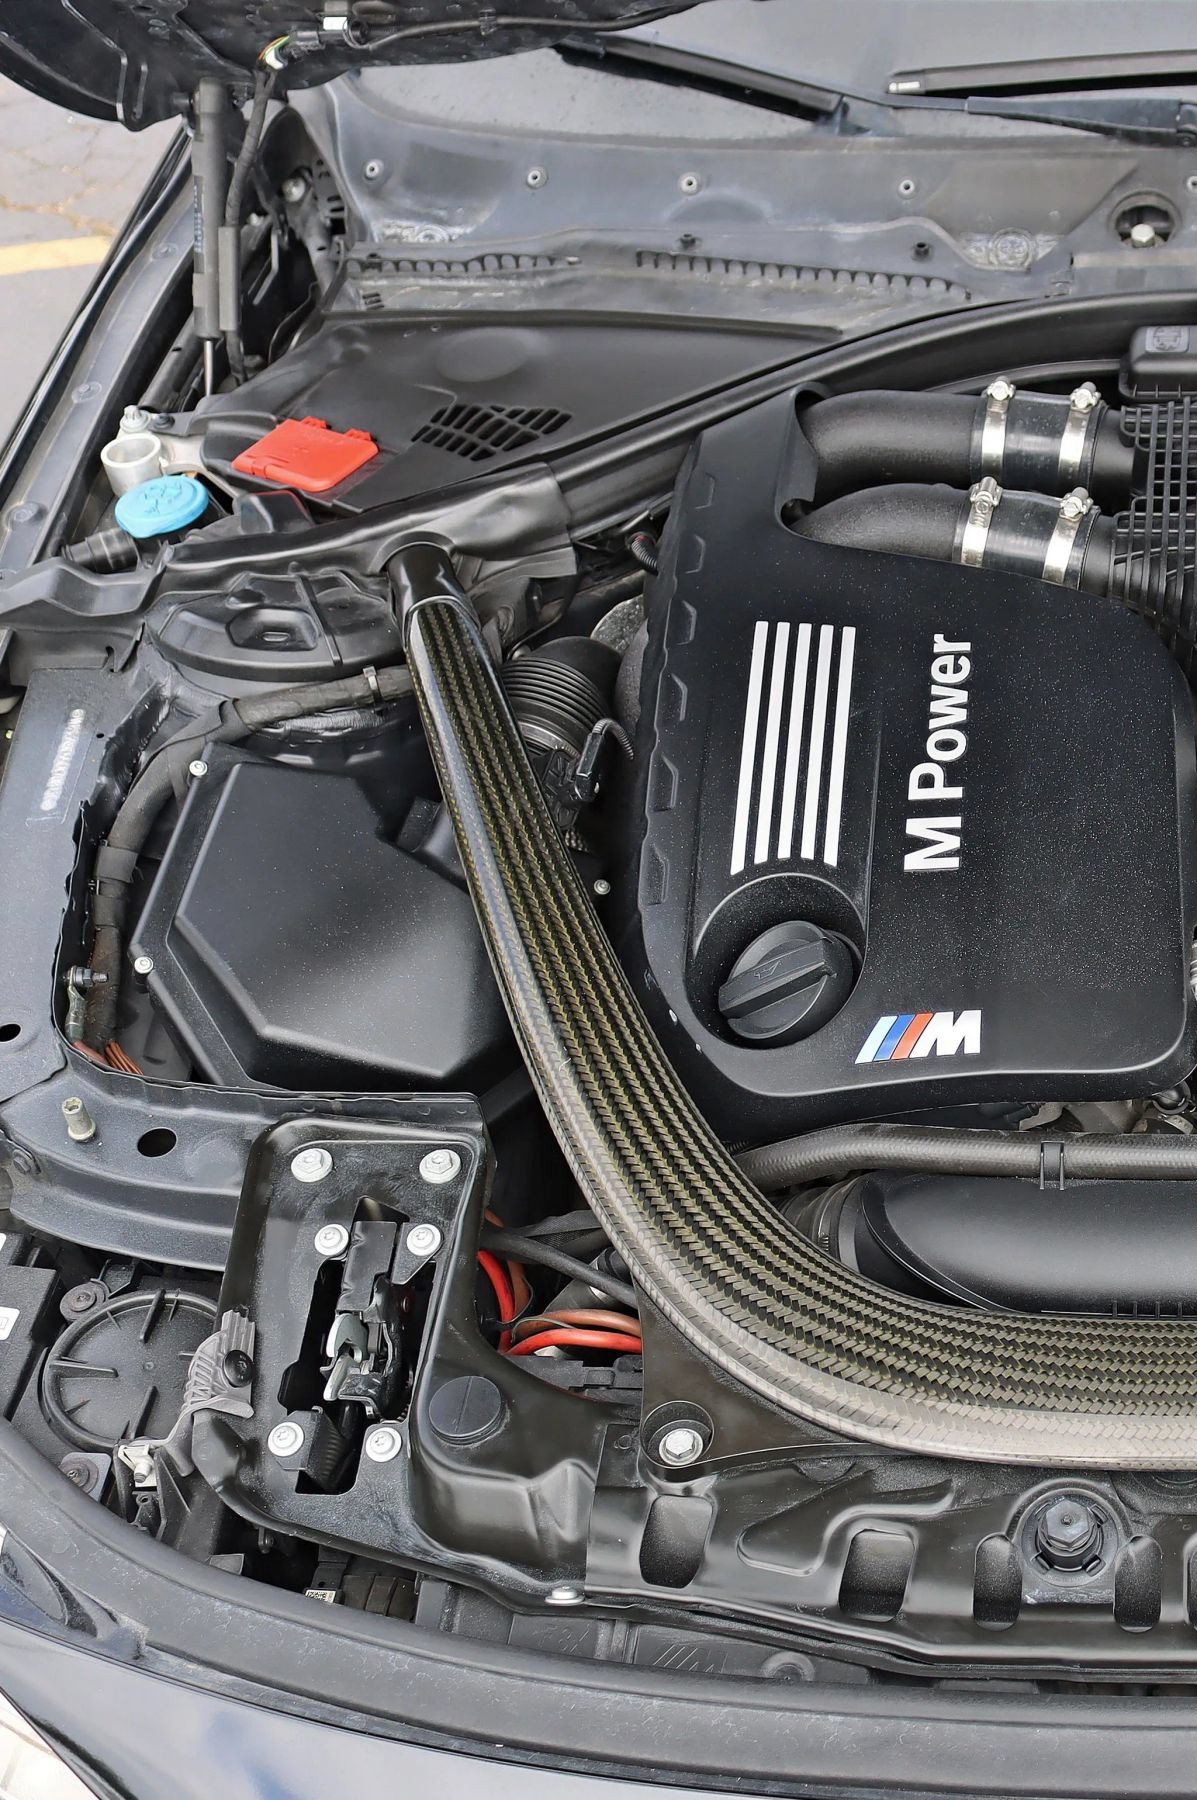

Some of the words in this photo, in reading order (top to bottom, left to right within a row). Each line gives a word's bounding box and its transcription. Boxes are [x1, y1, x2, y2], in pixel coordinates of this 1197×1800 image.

[908, 634, 972, 801] Power
[903, 816, 962, 872] M
[909, 1009, 982, 1058] M
